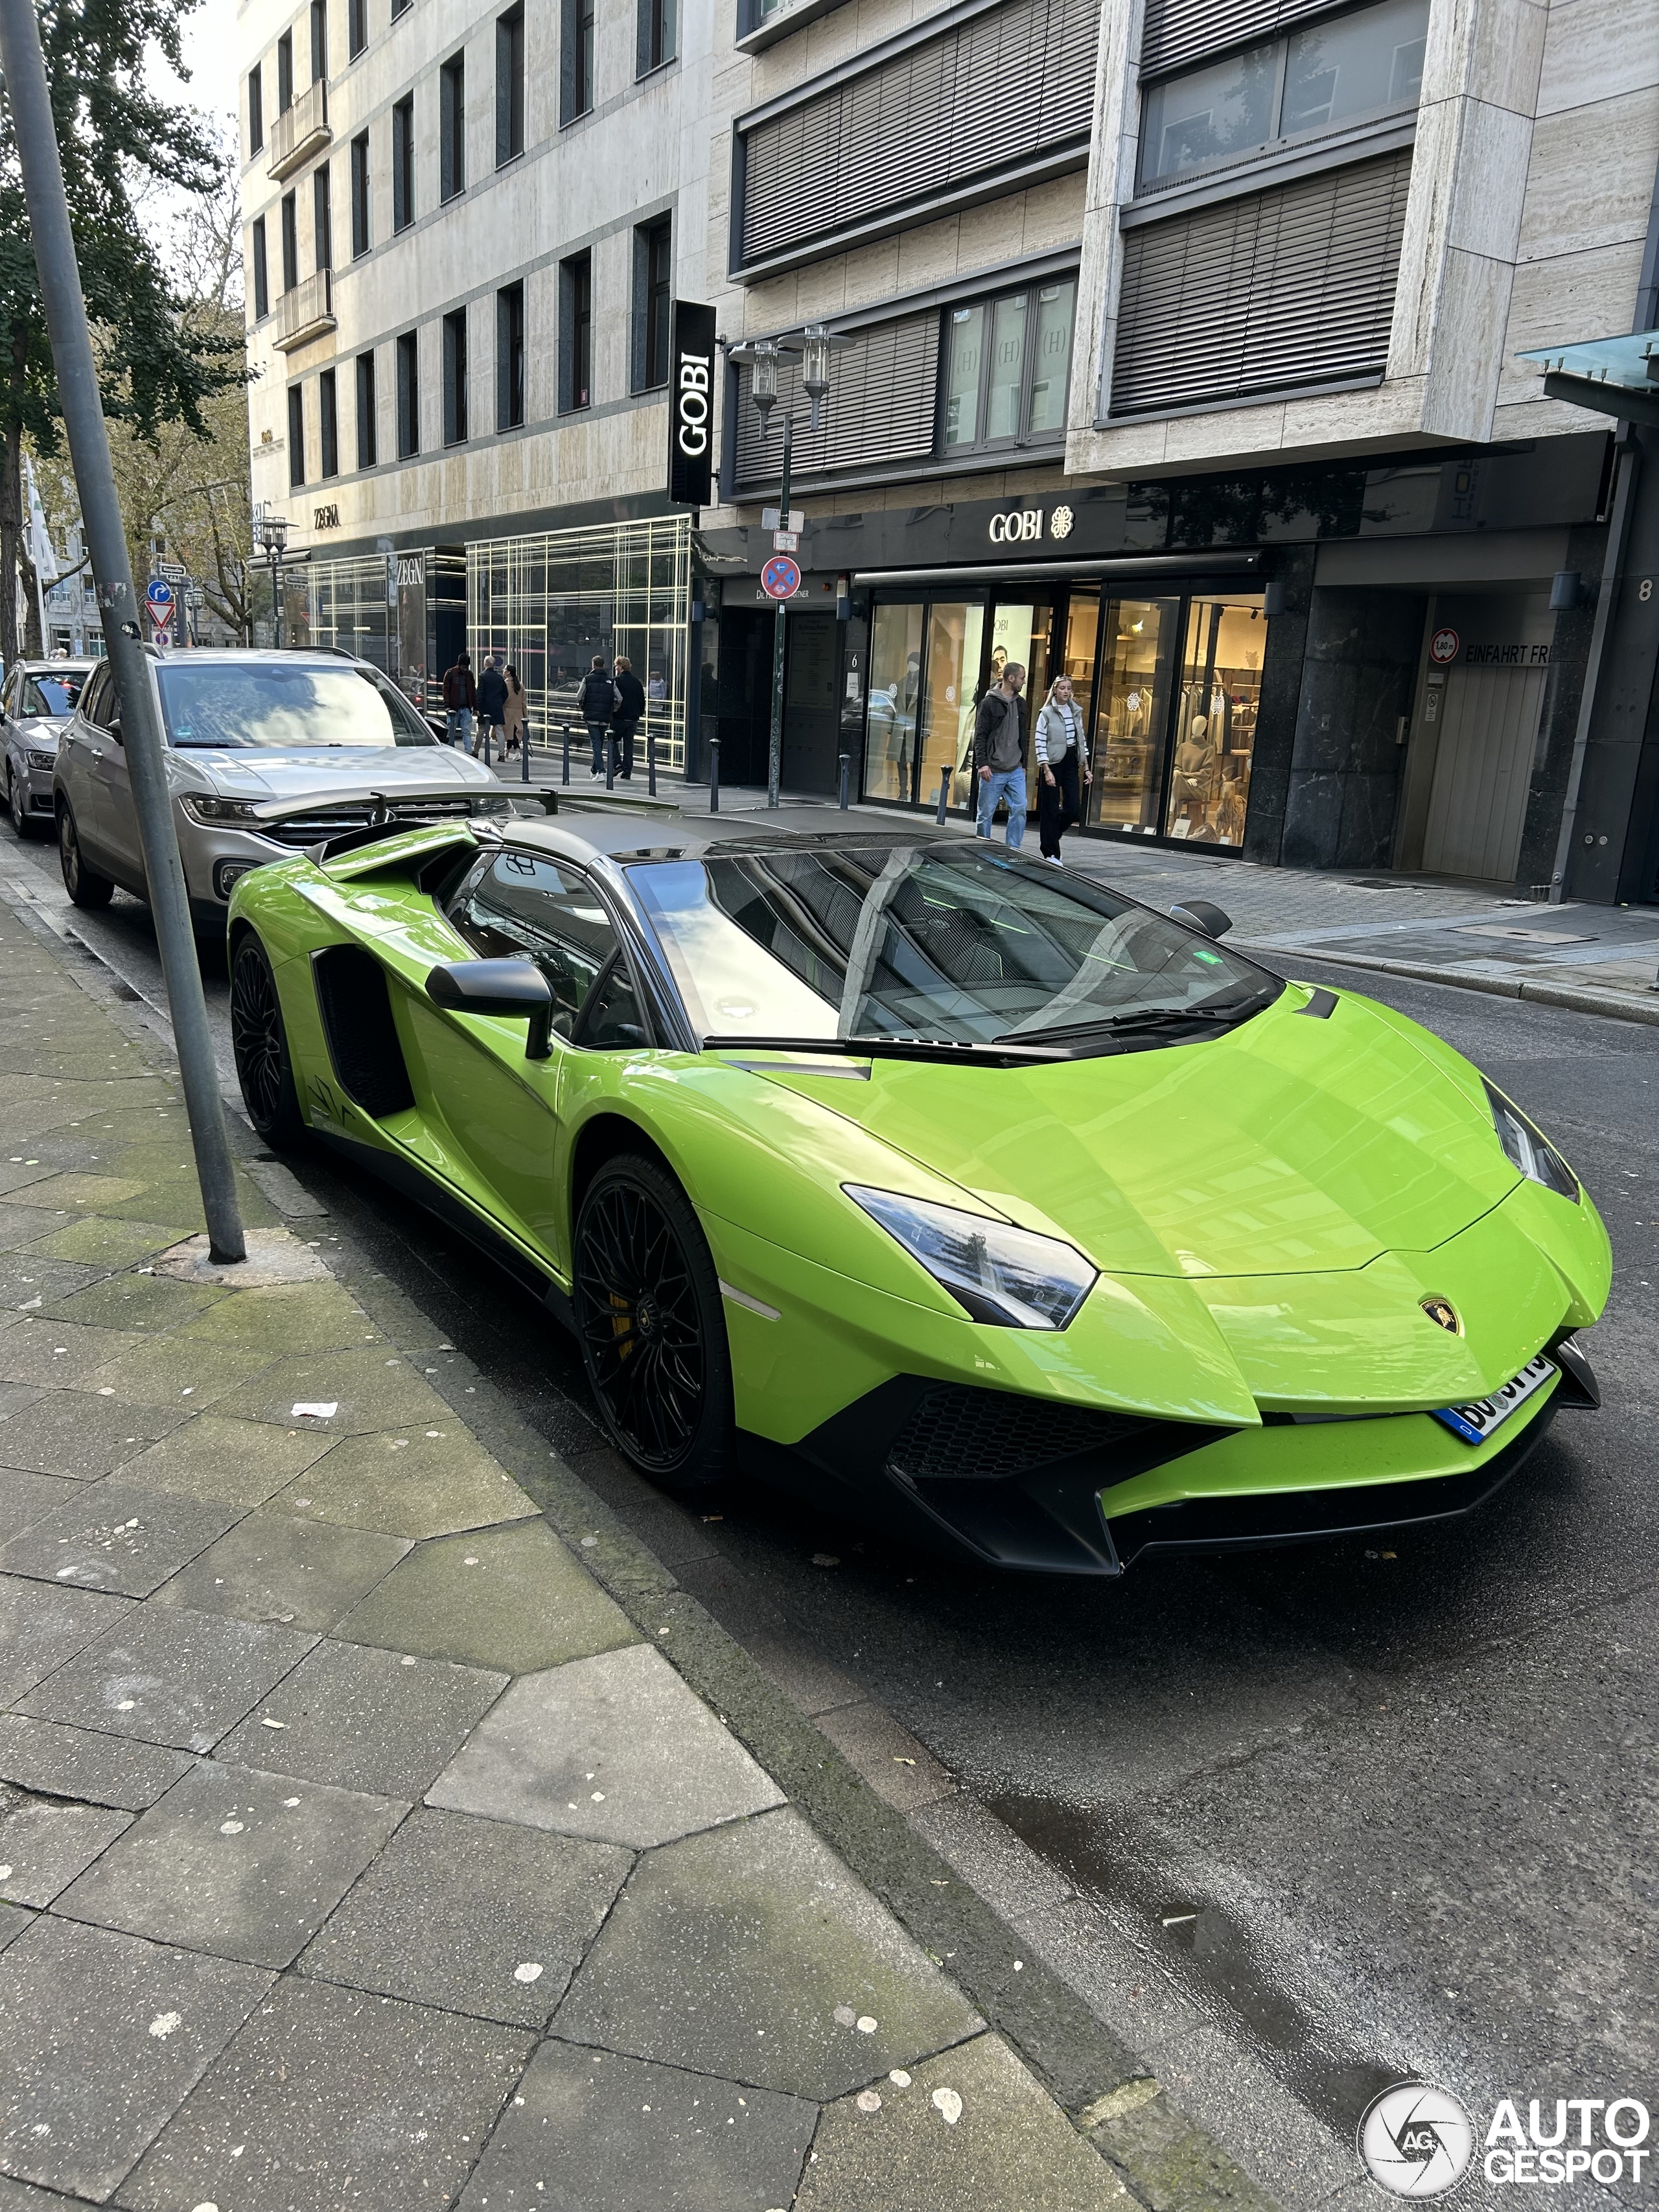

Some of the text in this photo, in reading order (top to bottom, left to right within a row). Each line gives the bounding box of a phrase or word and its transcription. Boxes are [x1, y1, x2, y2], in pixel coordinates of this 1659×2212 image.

[679, 353, 710, 456] GOBI
[314, 504, 340, 530] ZEGNA
[989, 509, 1043, 543] GOBI
[791, 590, 809, 598] ARTNER
[1639, 579, 1653, 601] 8
[994, 620, 1008, 631] OBI
[1435, 640, 1448, 651] 1,80
[1466, 645, 1527, 663] EINFAHRT
[852, 654, 857, 668] 6
